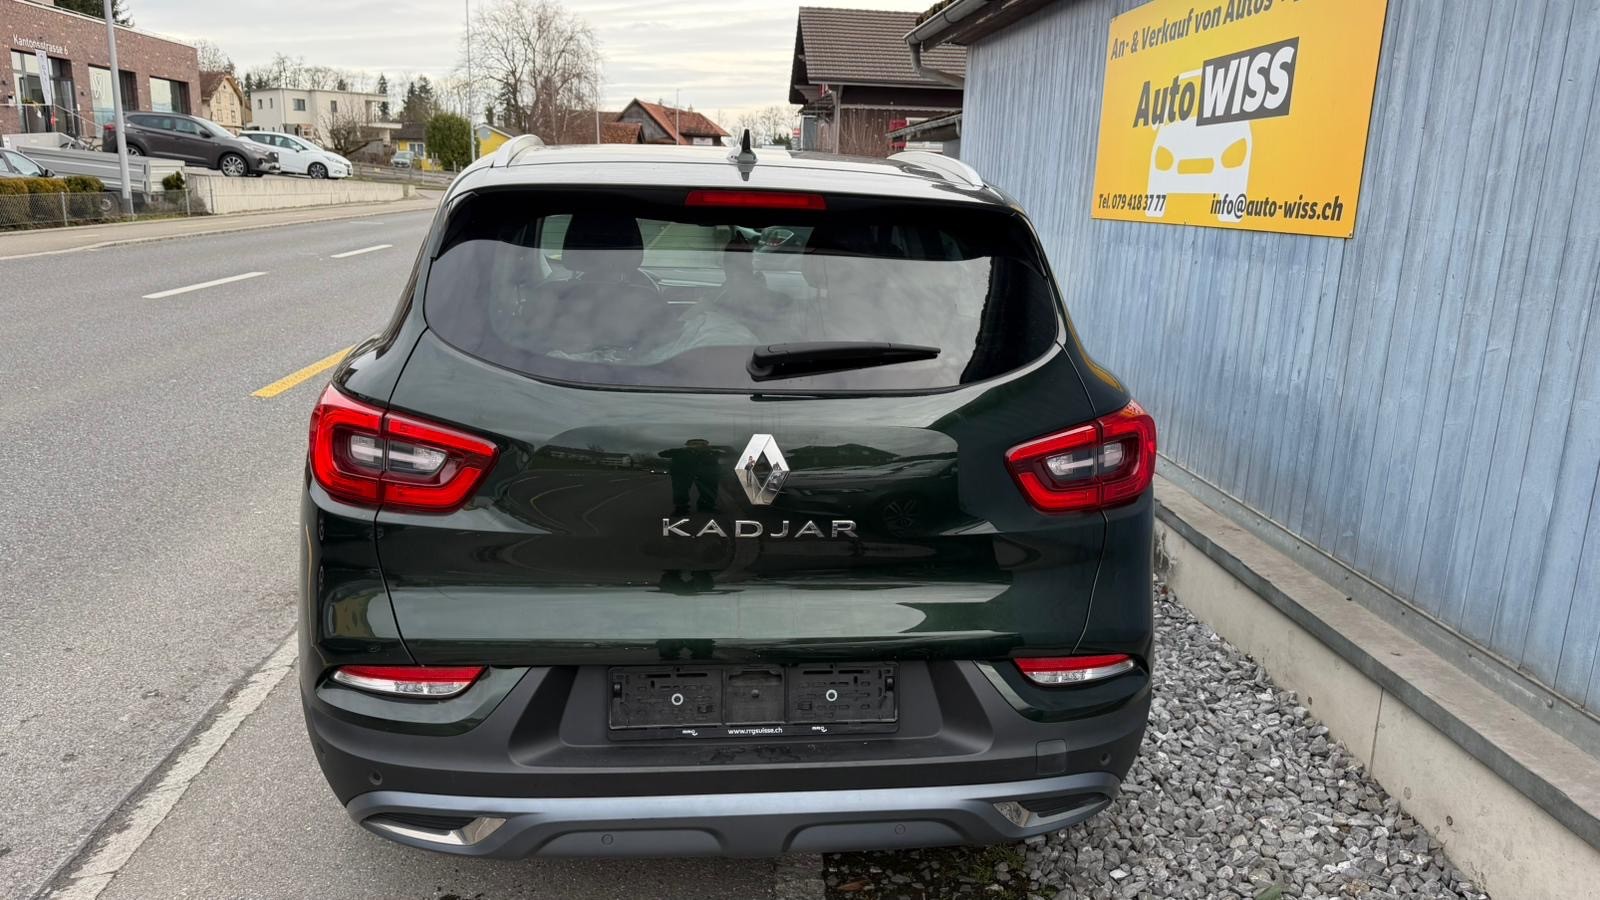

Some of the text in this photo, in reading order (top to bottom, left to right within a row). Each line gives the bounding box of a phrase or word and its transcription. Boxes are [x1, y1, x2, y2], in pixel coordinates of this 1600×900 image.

[1110, 0, 1273, 60] An- & Verkauf von Autos
[13, 34, 69, 55] Kantonsstrasse 6
[1132, 46, 1295, 128] Auto WISS
[1098, 193, 1111, 209] Tel.
[1112, 194, 1127, 210] 079
[1127, 194, 1143, 211] 418
[1210, 193, 1344, 222] info@auto-wiss.ch
[661, 518, 859, 538] KADJAR
